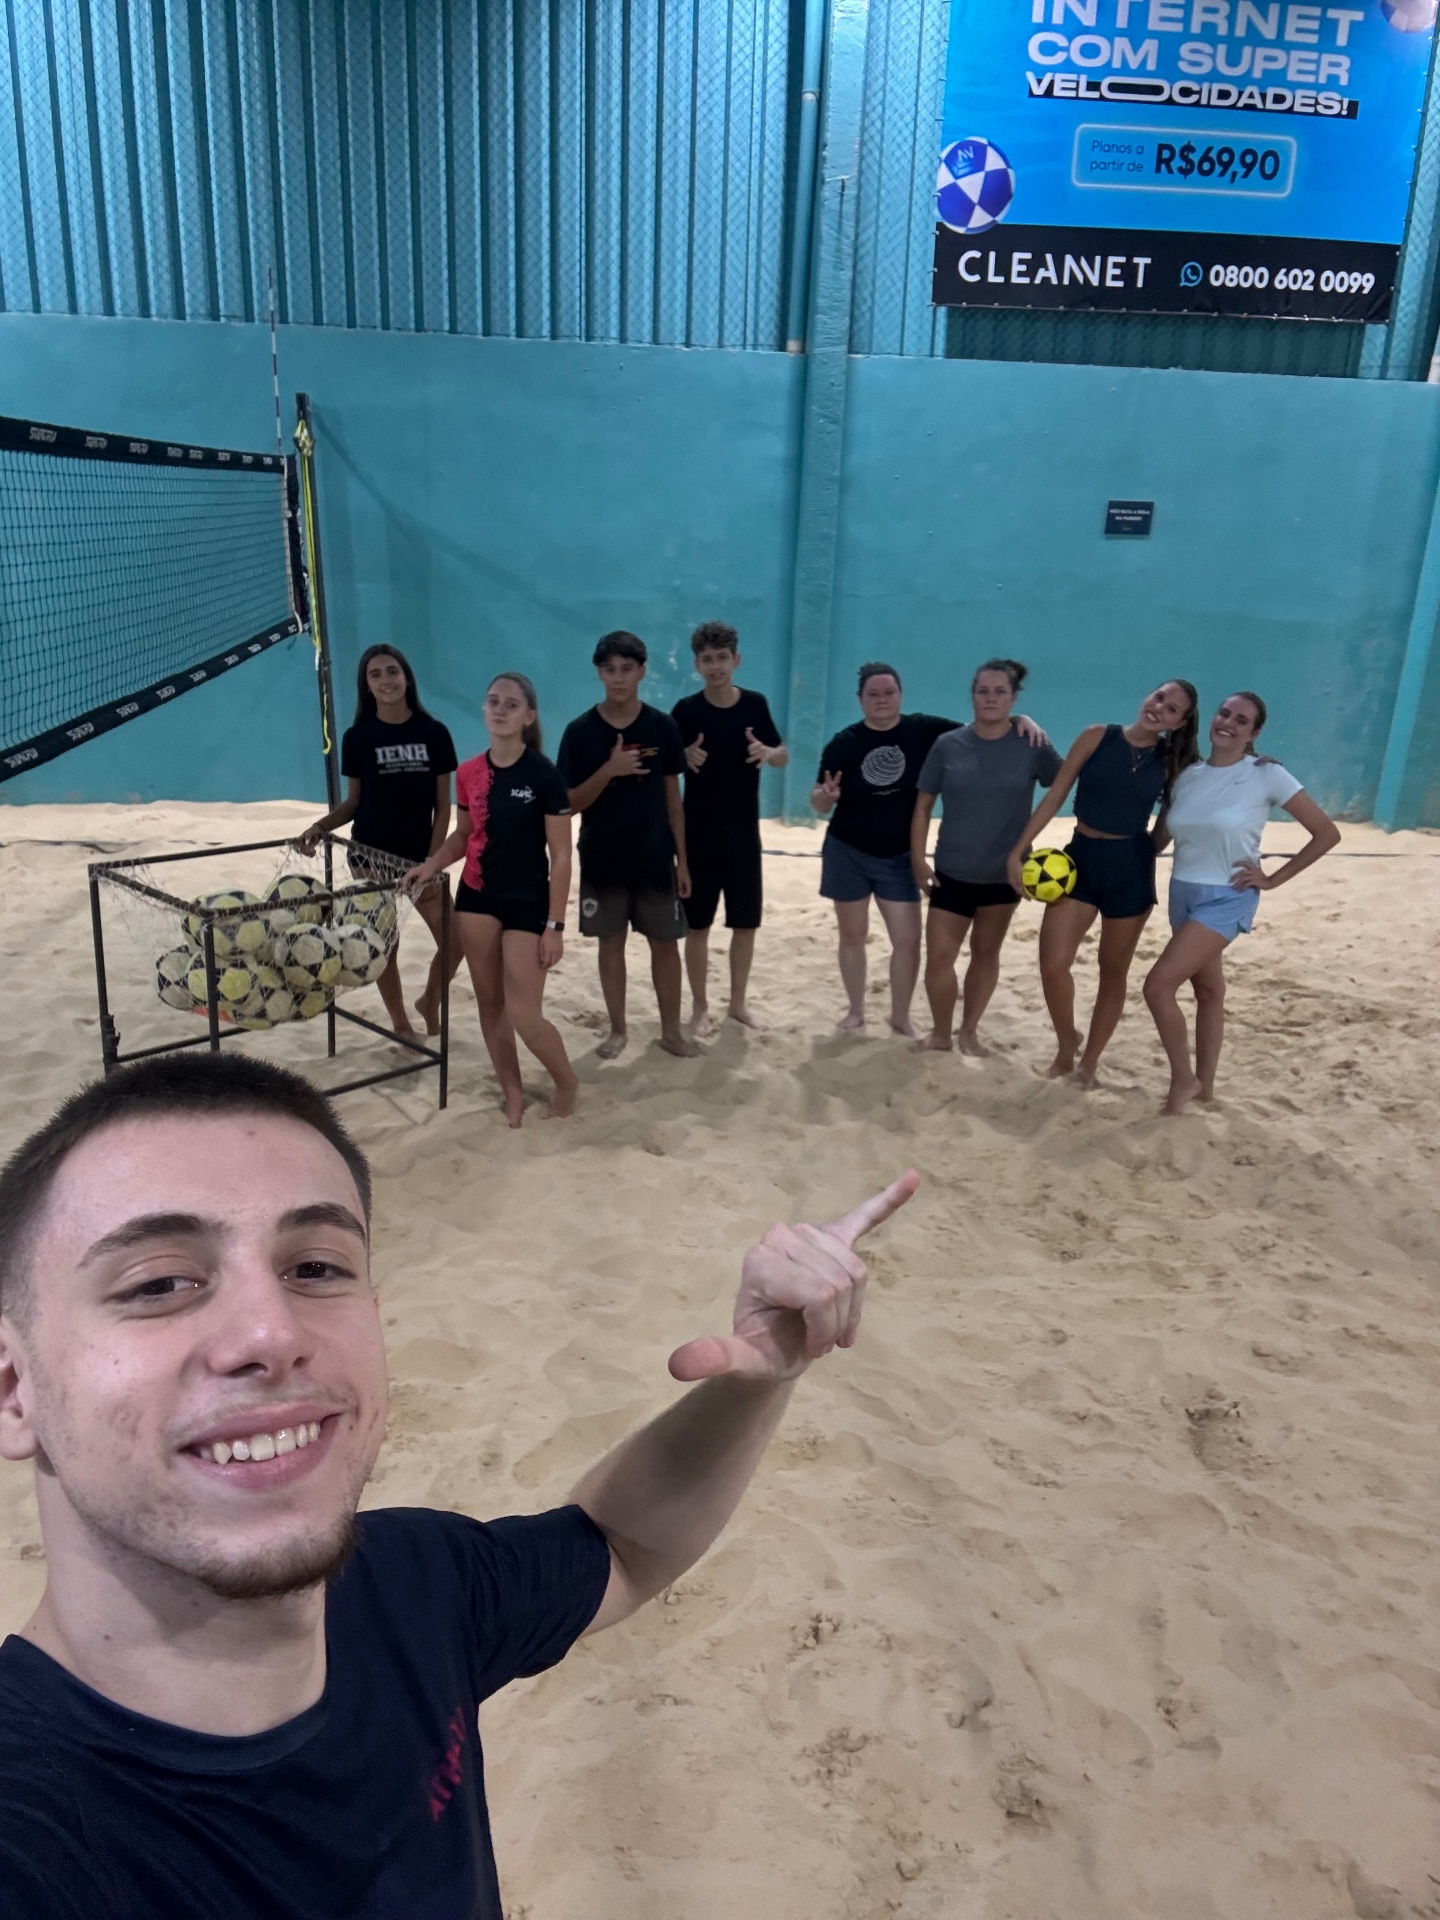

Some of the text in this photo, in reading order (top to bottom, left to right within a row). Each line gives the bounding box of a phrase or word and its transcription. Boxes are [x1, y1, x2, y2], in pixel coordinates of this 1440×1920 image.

[1031, 0, 1364, 46] INTERNET
[1028, 32, 1350, 86] COM SUPER
[1025, 71, 1349, 116] VELOCIDADES!
[1090, 159, 1144, 173] partir de
[1091, 140, 1144, 154] Planos a
[1155, 140, 1280, 184] R$69,90
[958, 250, 1152, 288] CLEANNET
[1209, 264, 1375, 294] 0800 602 0099
